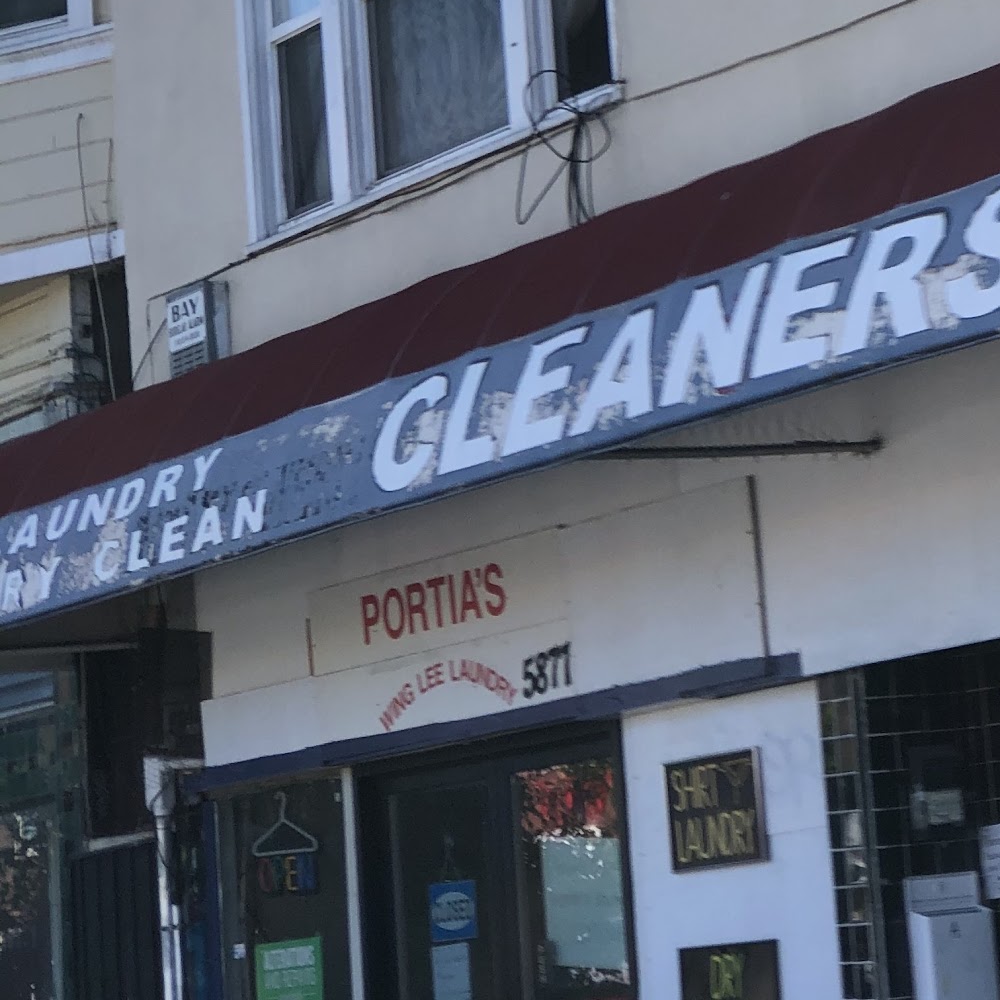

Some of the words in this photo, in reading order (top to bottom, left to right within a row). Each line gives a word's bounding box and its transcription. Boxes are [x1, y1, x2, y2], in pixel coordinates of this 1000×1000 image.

[4, 447, 224, 555] AUNDRY
[0, 556, 62, 608] RY
[93, 488, 269, 582] CLEAN
[360, 562, 507, 646] PORTIA'S
[416, 662, 445, 694] LEE
[522, 640, 573, 700] 5877
